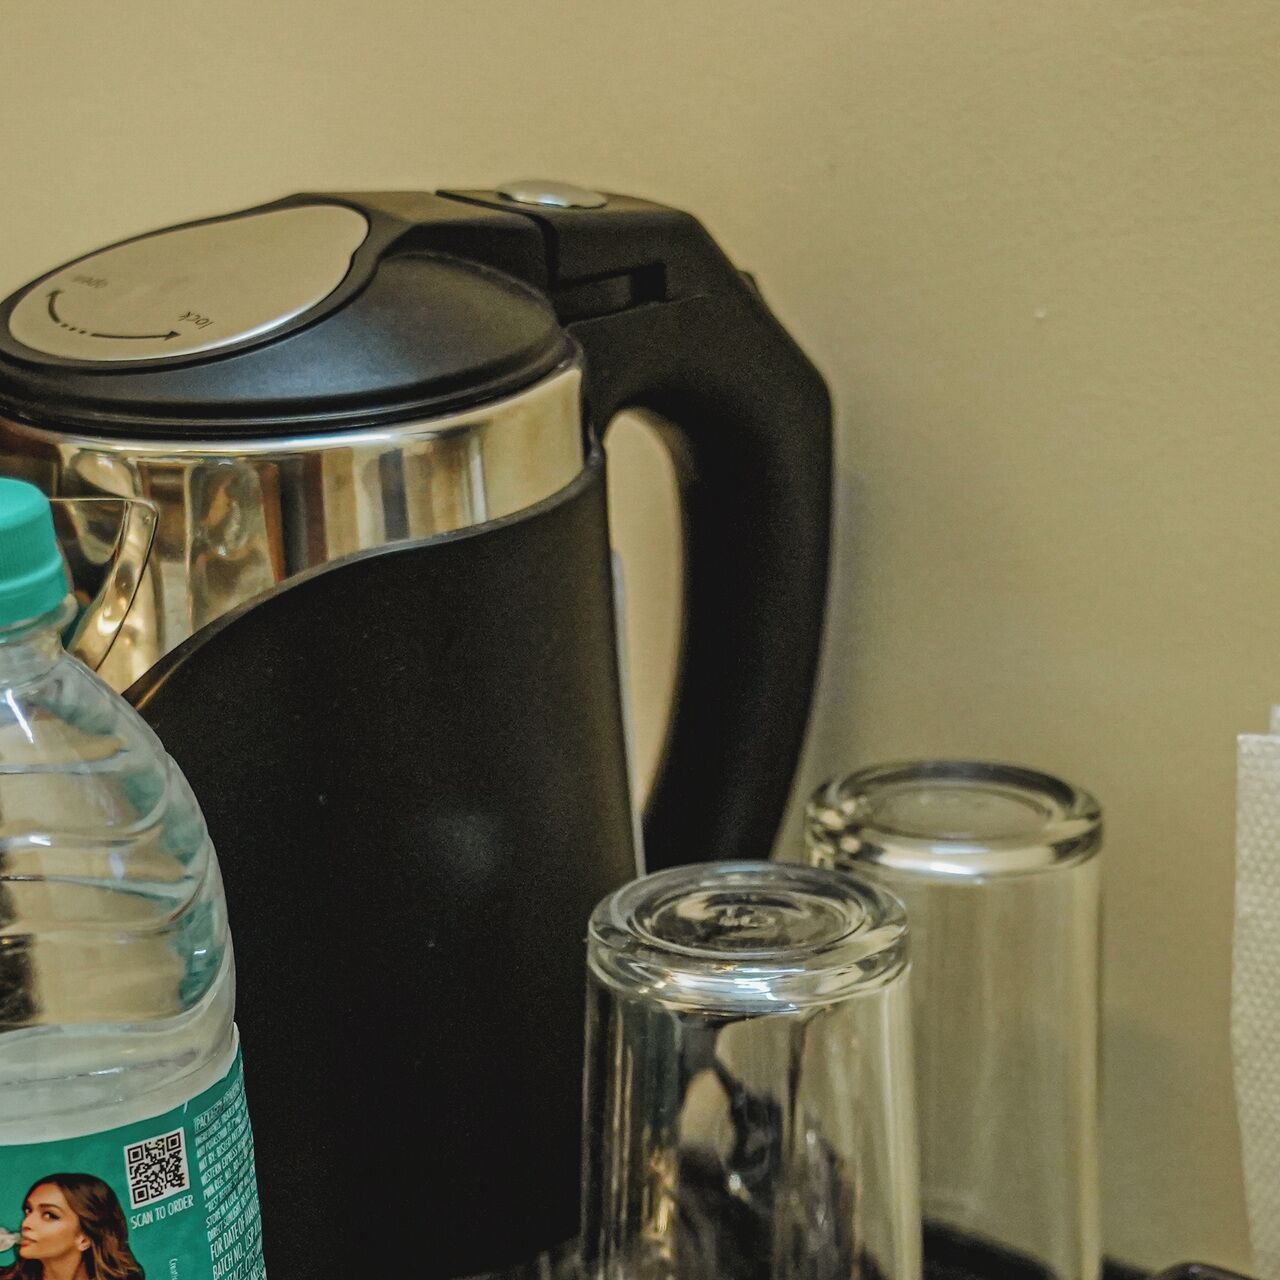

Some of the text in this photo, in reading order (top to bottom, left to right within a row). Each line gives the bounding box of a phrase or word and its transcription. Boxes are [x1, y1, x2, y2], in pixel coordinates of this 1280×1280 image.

[177, 311, 214, 330] lock
[131, 1195, 194, 1230] SCAN TO ORDER
[211, 1238, 224, 1261] FOR
[223, 1223, 239, 1251] DATE
[238, 1215, 246, 1237] OF
[212, 1249, 233, 1280] BATCH
